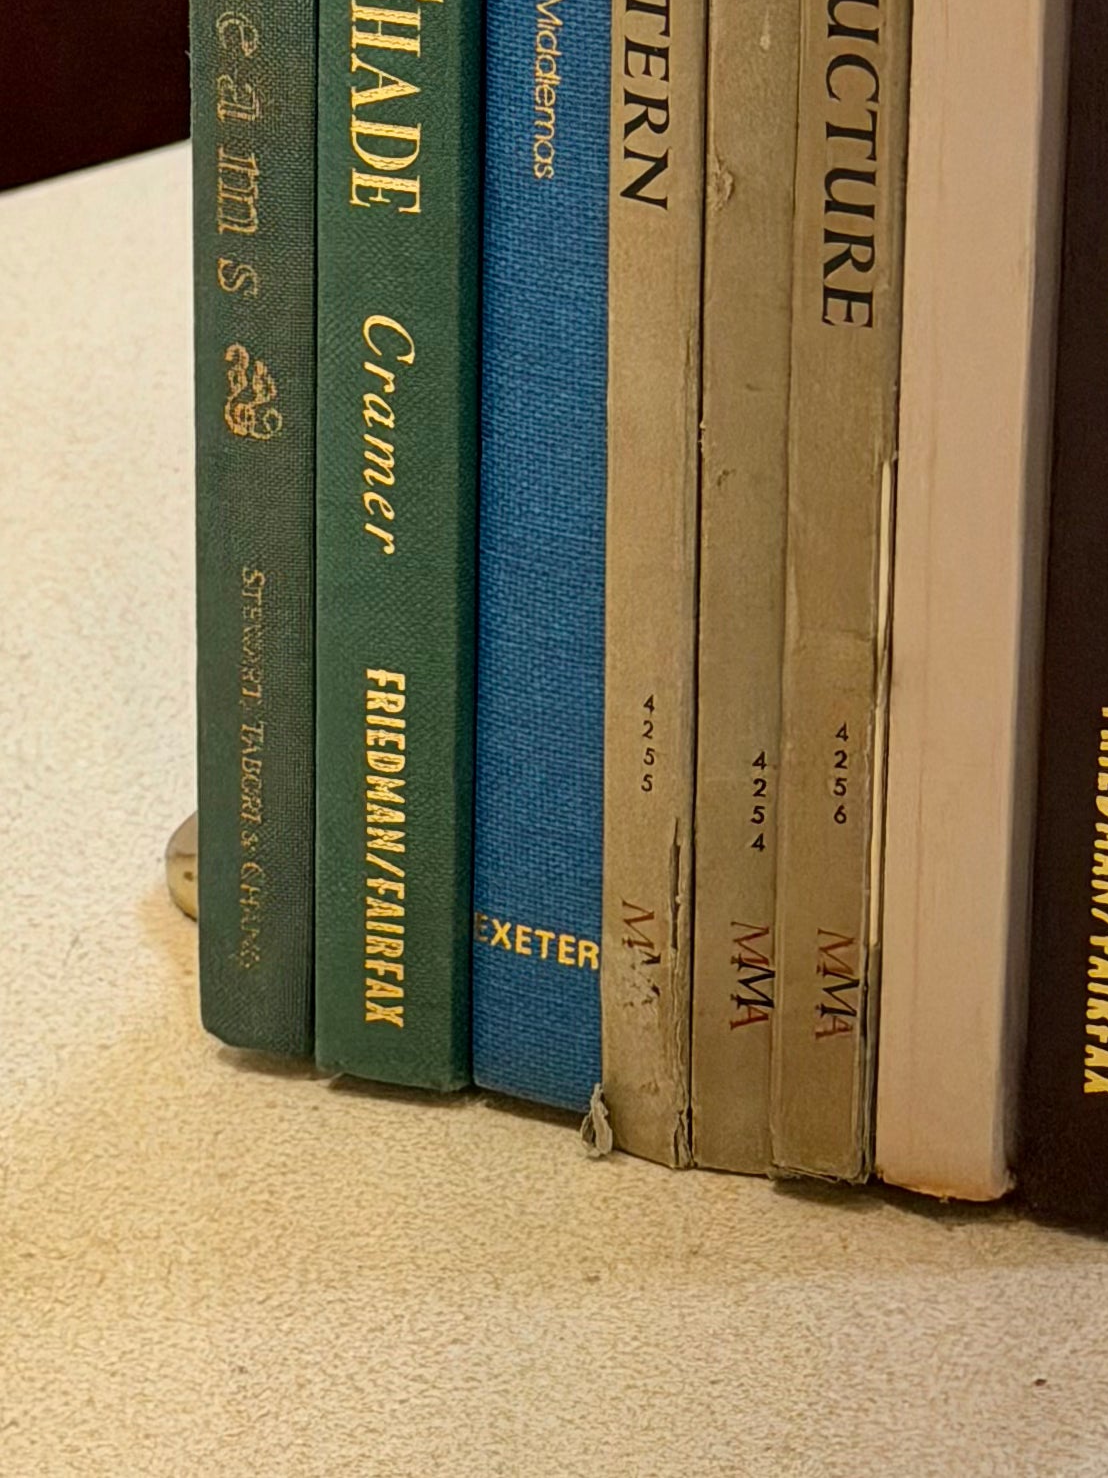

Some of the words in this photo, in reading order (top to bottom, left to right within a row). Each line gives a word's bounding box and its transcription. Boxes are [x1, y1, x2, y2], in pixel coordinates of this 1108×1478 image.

[363, 315, 415, 554] Cramer
[641, 695, 655, 792] 4255
[834, 723, 848, 824] 4256
[365, 669, 405, 1027] FRIEDMAN/FAIRFAX
[751, 751, 766, 852] 4254
[474, 911, 599, 970] EXETER
